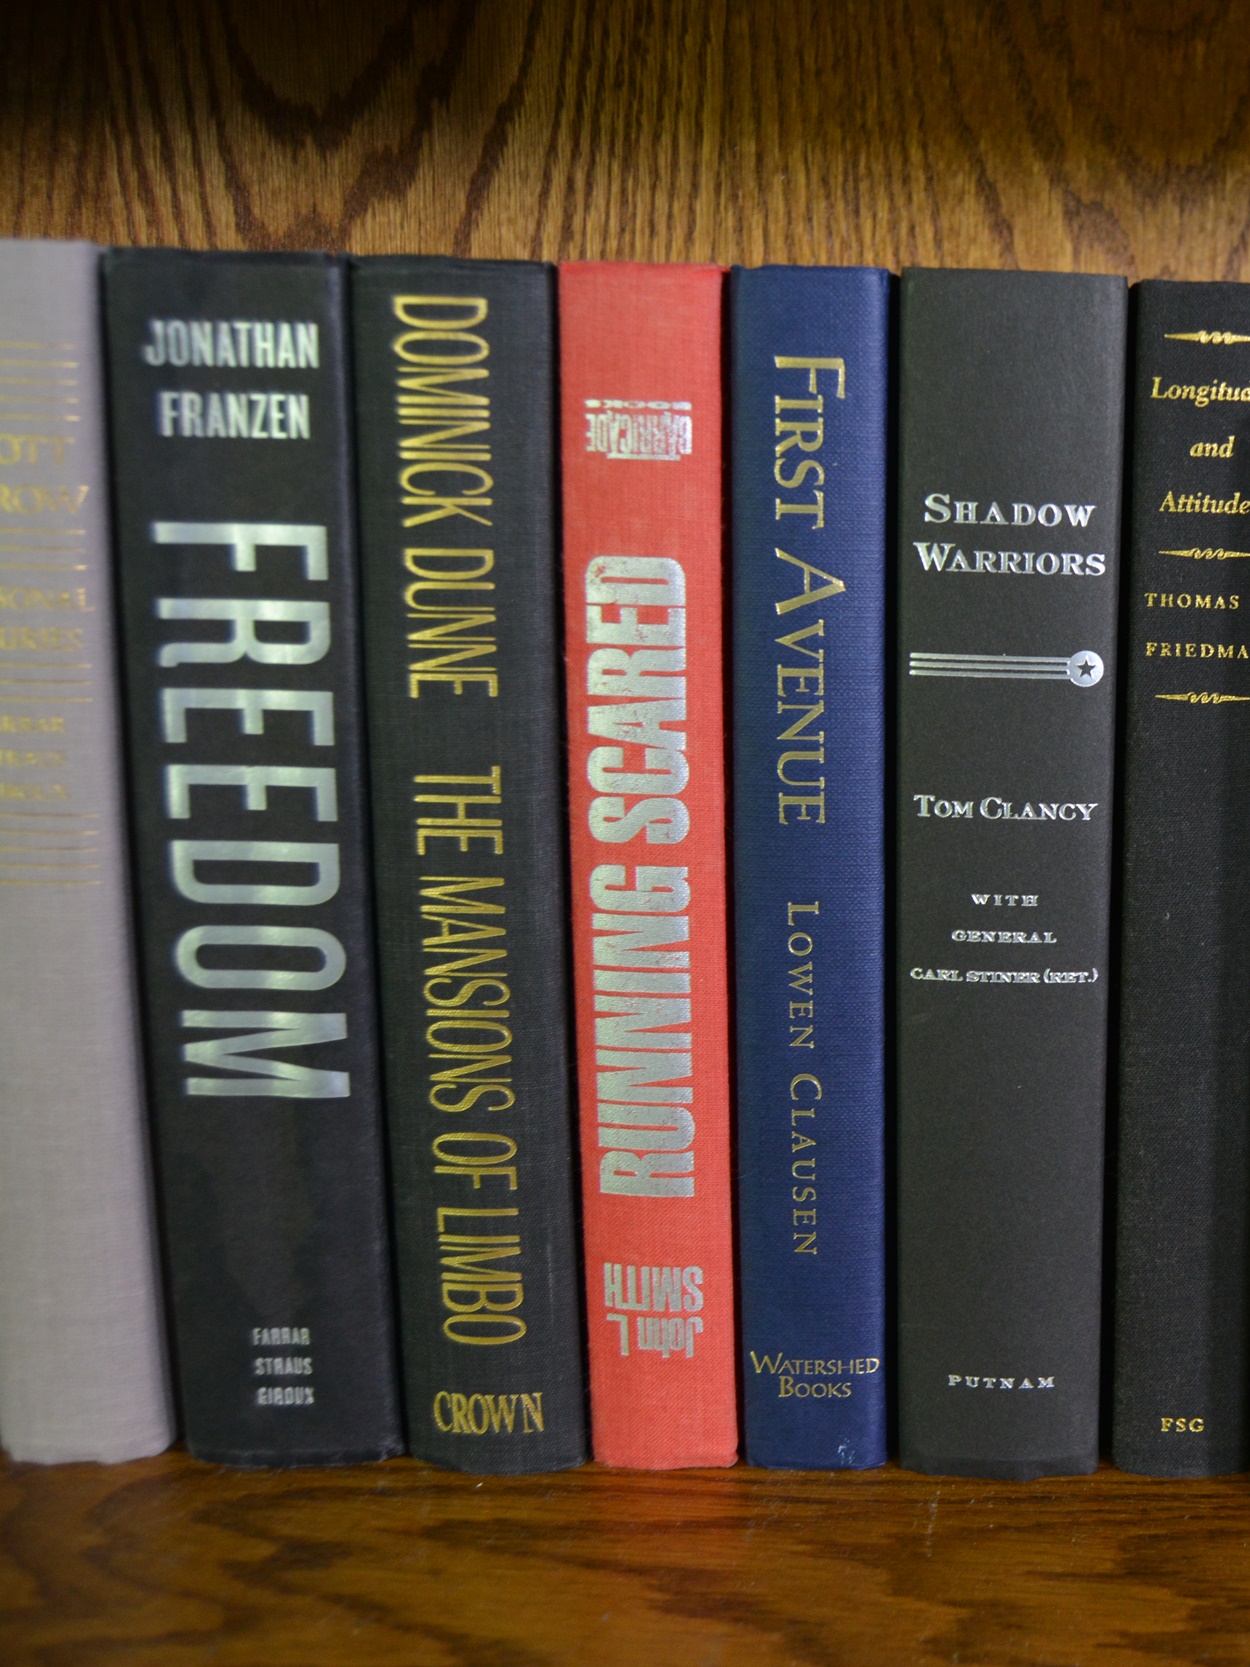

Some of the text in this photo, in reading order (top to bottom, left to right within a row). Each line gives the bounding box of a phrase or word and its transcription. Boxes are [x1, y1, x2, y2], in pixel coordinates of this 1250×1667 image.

[143, 320, 319, 369] JONATHAN
[158, 391, 311, 439] FRANZEN
[1190, 437, 1235, 459] and
[392, 294, 499, 698] DOMINICK DUNNE
[924, 494, 1097, 528] SHADOW
[913, 542, 1106, 577] WARRIORS
[773, 356, 847, 825] FIRST AVENUE
[1145, 592, 1240, 611] THOMAS
[152, 521, 351, 1099] FREEDOM
[913, 795, 1098, 822] TOM CLANCY
[584, 556, 697, 1198] RUNNING SCARED
[971, 893, 1039, 907] WITH
[951, 930, 1058, 944] GENERAL
[910, 967, 1099, 985] CARL STINER (RET.)
[413, 765, 527, 1345] THE MANSIONS OF LIMBO
[787, 901, 822, 1255] LOWEN CLAUSEN
[604, 1262, 704, 1312] SMITH
[252, 1327, 310, 1346] FARRAR
[606, 1313, 704, 1358] John L
[255, 1357, 313, 1375] STRAUS
[750, 1351, 880, 1376] WATERSHED
[258, 1386, 314, 1405] GIROUX
[778, 1376, 852, 1399] BOOKS
[948, 1375, 1055, 1390] PUTNAM
[434, 1390, 545, 1434] CROWN
[1161, 1418, 1204, 1432] FSG
